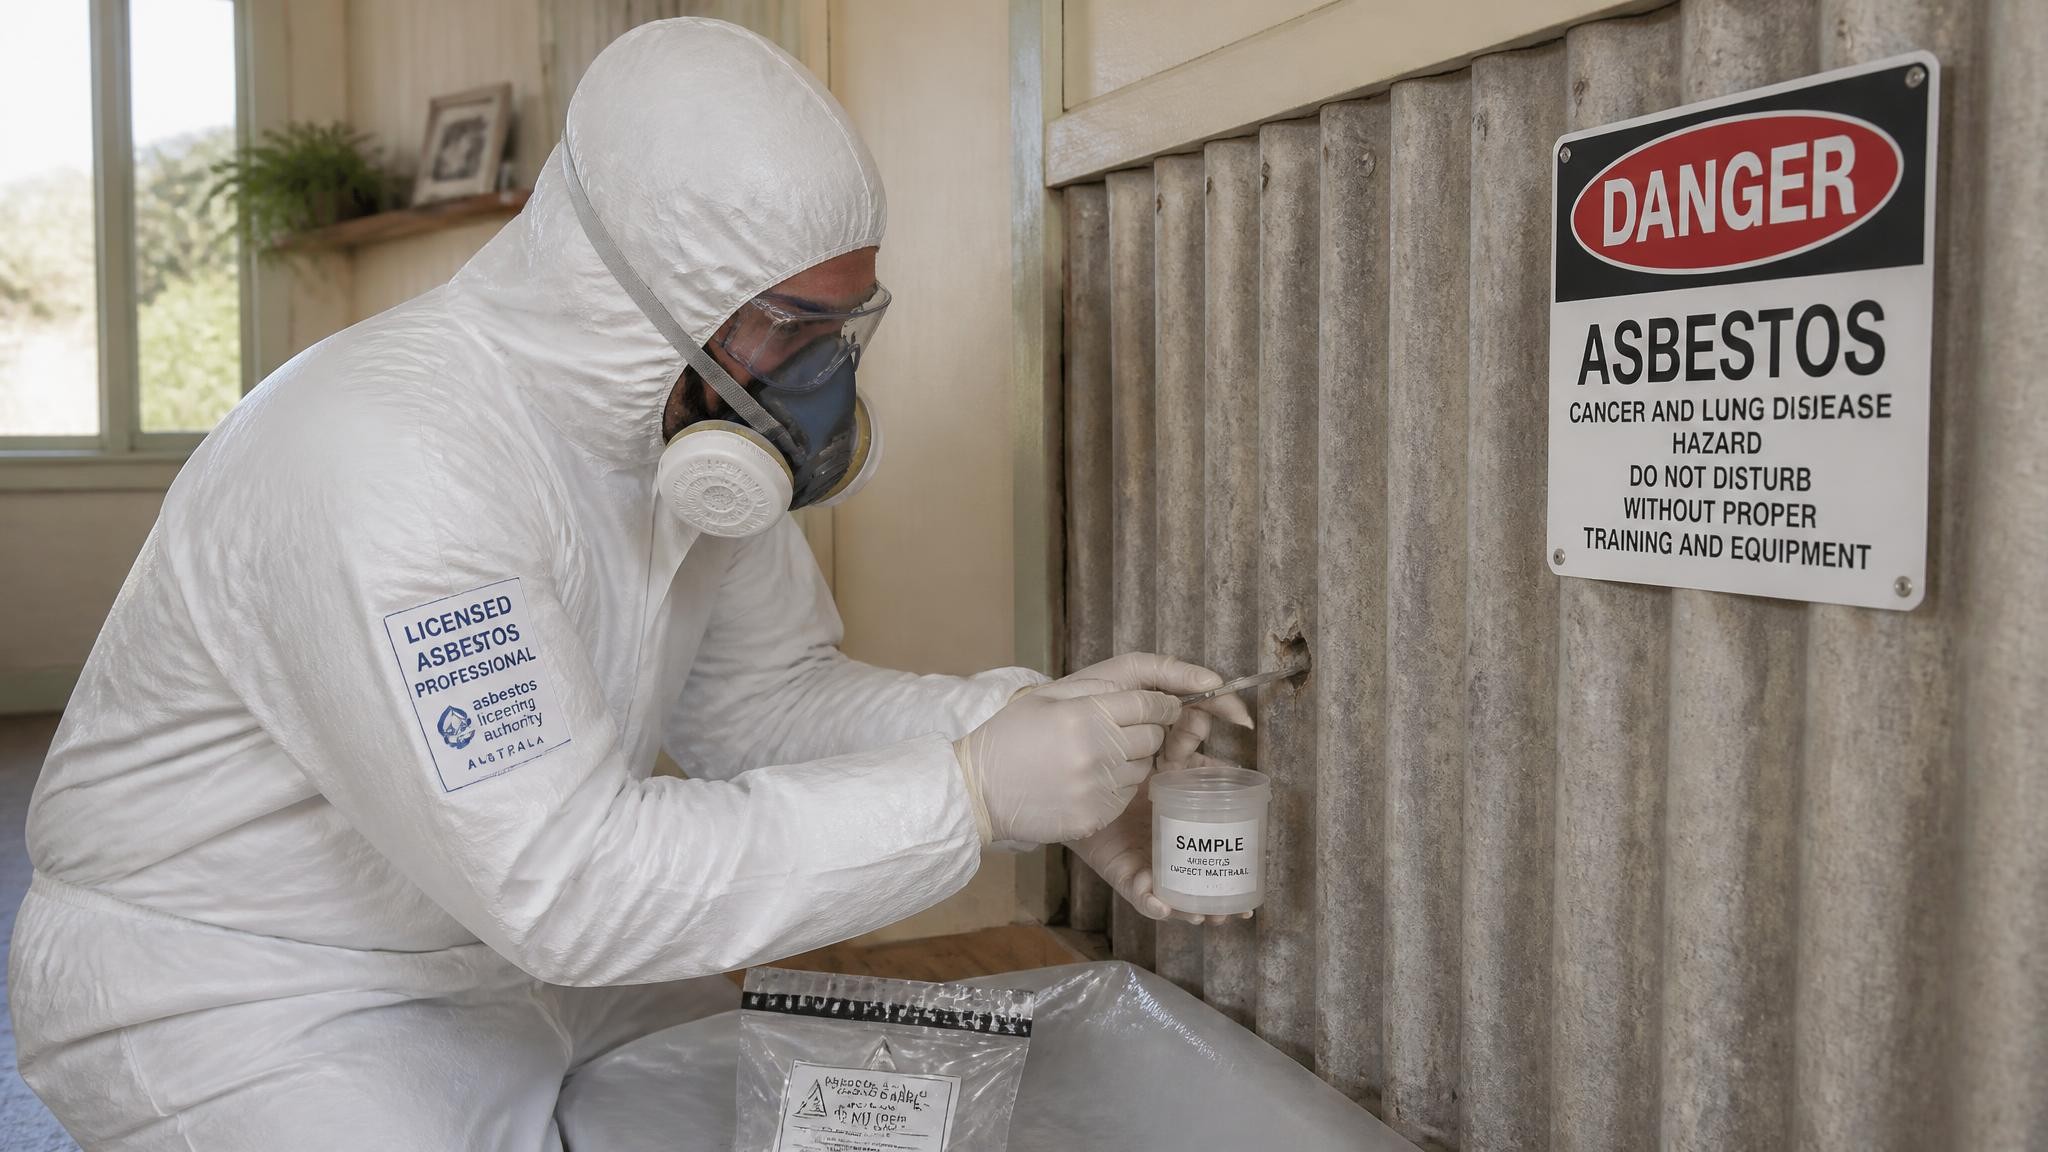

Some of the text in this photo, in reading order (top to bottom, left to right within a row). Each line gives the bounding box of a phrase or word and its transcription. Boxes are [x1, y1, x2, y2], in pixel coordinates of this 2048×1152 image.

[1603, 134, 1856, 247] DANGER
[1577, 299, 1886, 385] ASBESTOS
[1570, 400, 1645, 423] CANCER
[1652, 399, 1694, 422] AND
[1702, 397, 1764, 421] LUNG
[1673, 432, 1762, 454] HAZARD
[1630, 465, 1811, 491] DO NOT DISTURB
[1624, 497, 1817, 528] WITHOUT PROPER
[1584, 527, 1871, 570] TRAINING AND EQUIPMENT
[404, 595, 512, 644] LICENSED
[417, 624, 520, 672] ASBESTOS
[415, 647, 536, 698] PROFESSIONAL
[472, 680, 537, 711] asbestos
[1176, 836, 1243, 852] SAMPLE
